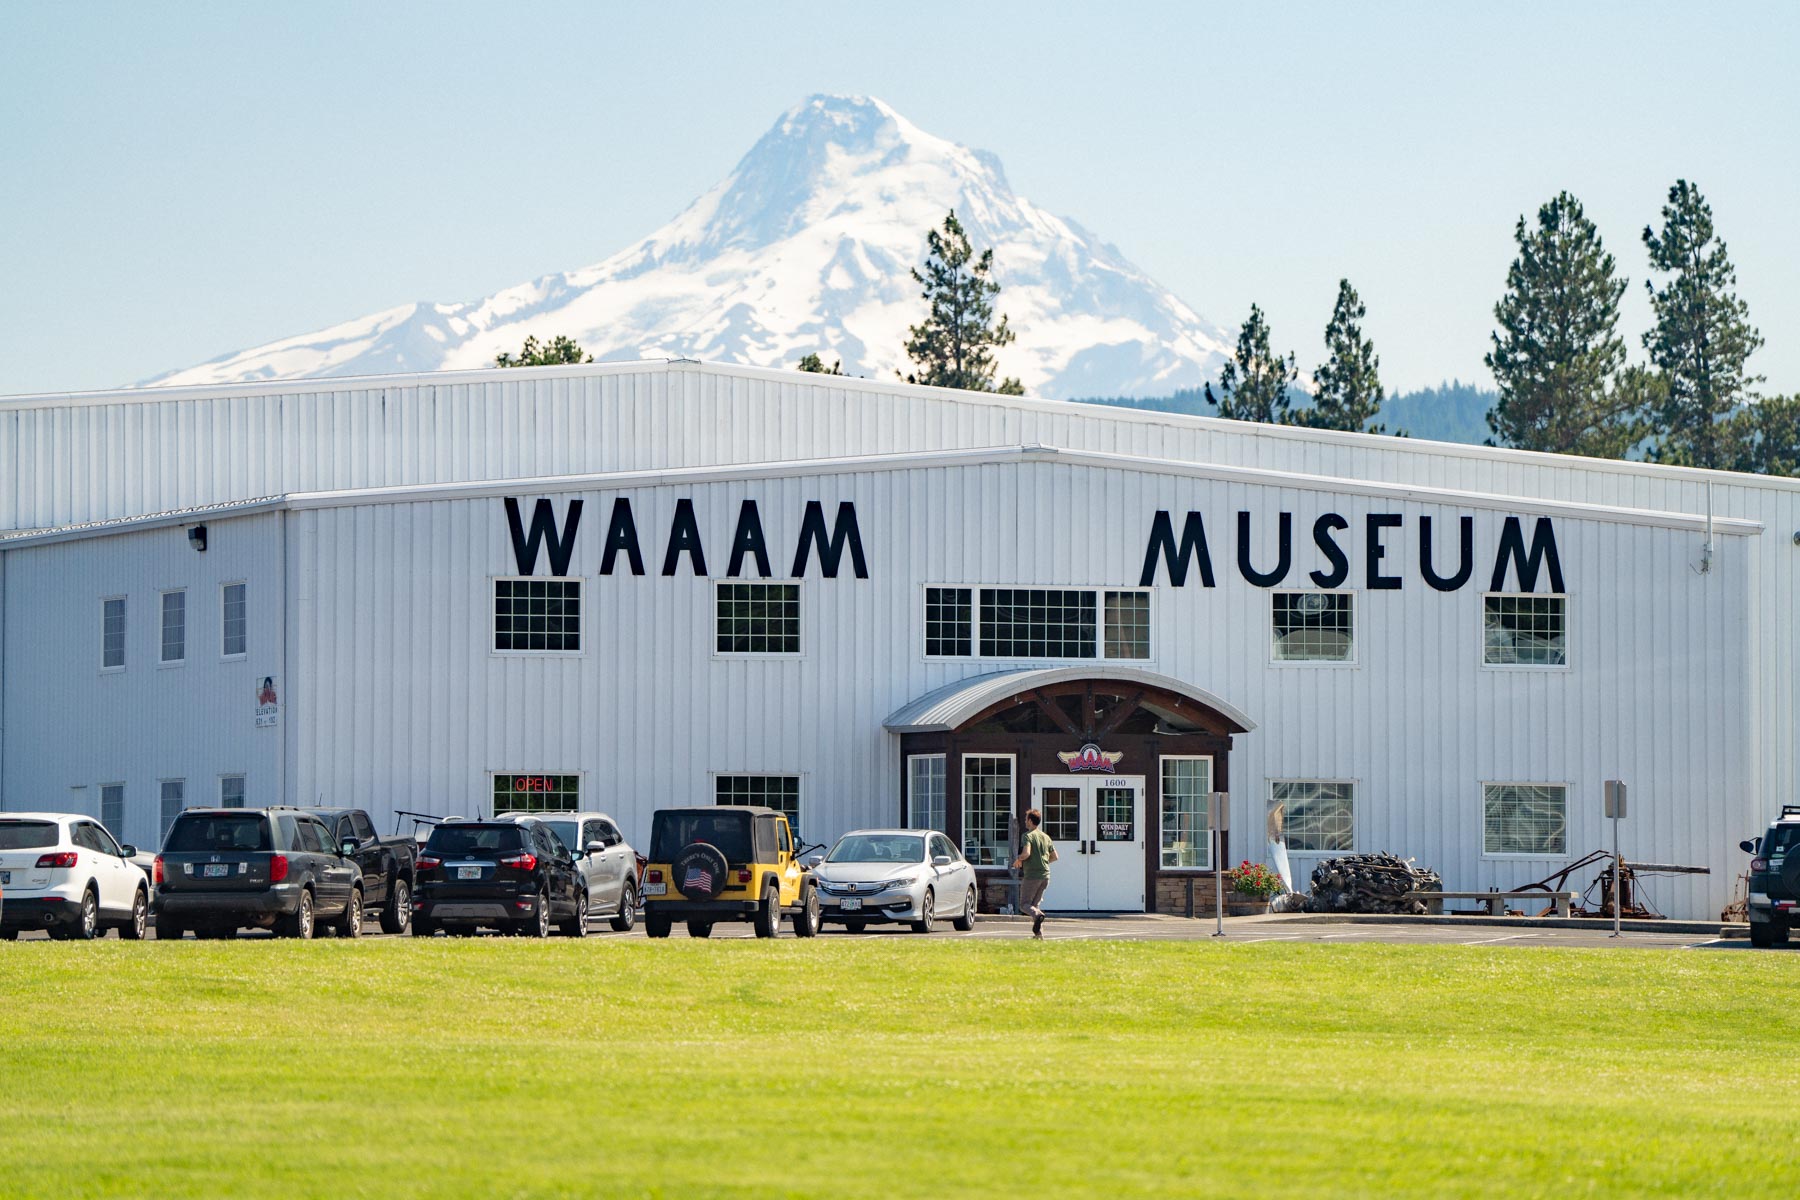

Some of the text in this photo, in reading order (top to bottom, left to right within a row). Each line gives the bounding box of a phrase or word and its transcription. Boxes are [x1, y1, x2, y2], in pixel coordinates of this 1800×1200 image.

[503, 496, 1566, 593] WAAAM MUSEUM
[515, 777, 553, 791] OPEN
